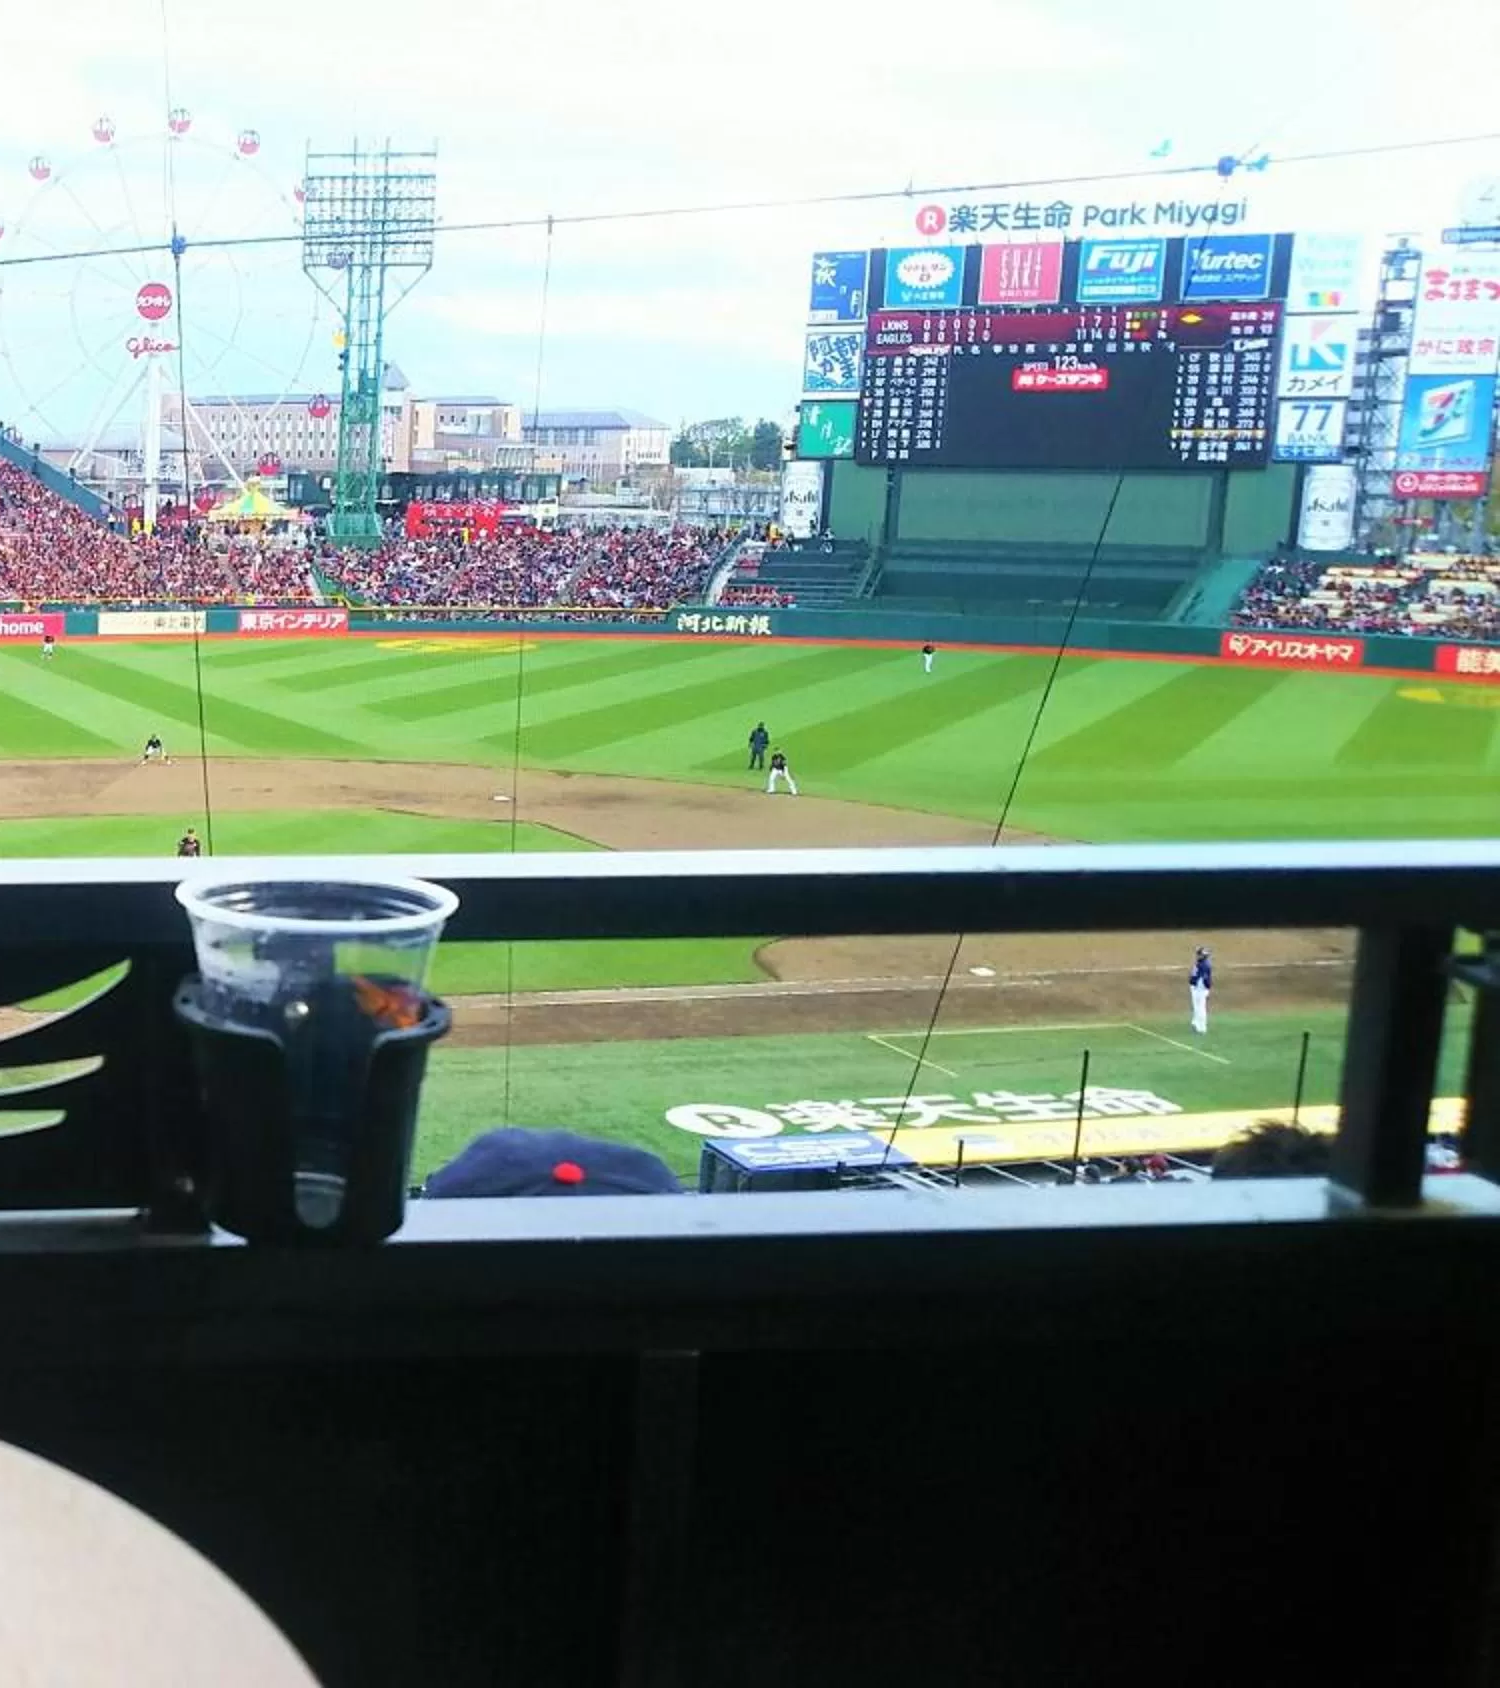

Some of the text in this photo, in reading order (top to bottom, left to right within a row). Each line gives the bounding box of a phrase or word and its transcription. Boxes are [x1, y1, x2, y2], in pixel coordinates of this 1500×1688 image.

[949, 202, 1072, 233] 楽天生命
[1083, 203, 1147, 229] Park
[1153, 197, 1248, 228] Miyagi
[1191, 248, 1265, 271] Yurtec
[881, 320, 909, 331] LIONS
[126, 337, 173, 359] Glico
[876, 332, 913, 344] EAGLES
[1054, 355, 1078, 370] 123
[1287, 376, 1343, 393] カメイ
[1292, 404, 1332, 431] 77
[240, 611, 347, 632] 東京インテリア
[677, 613, 772, 636] 河北新報
[1251, 636, 1355, 662] アイリスオーヤマ
[766, 1086, 1184, 1133] 楽天生命
